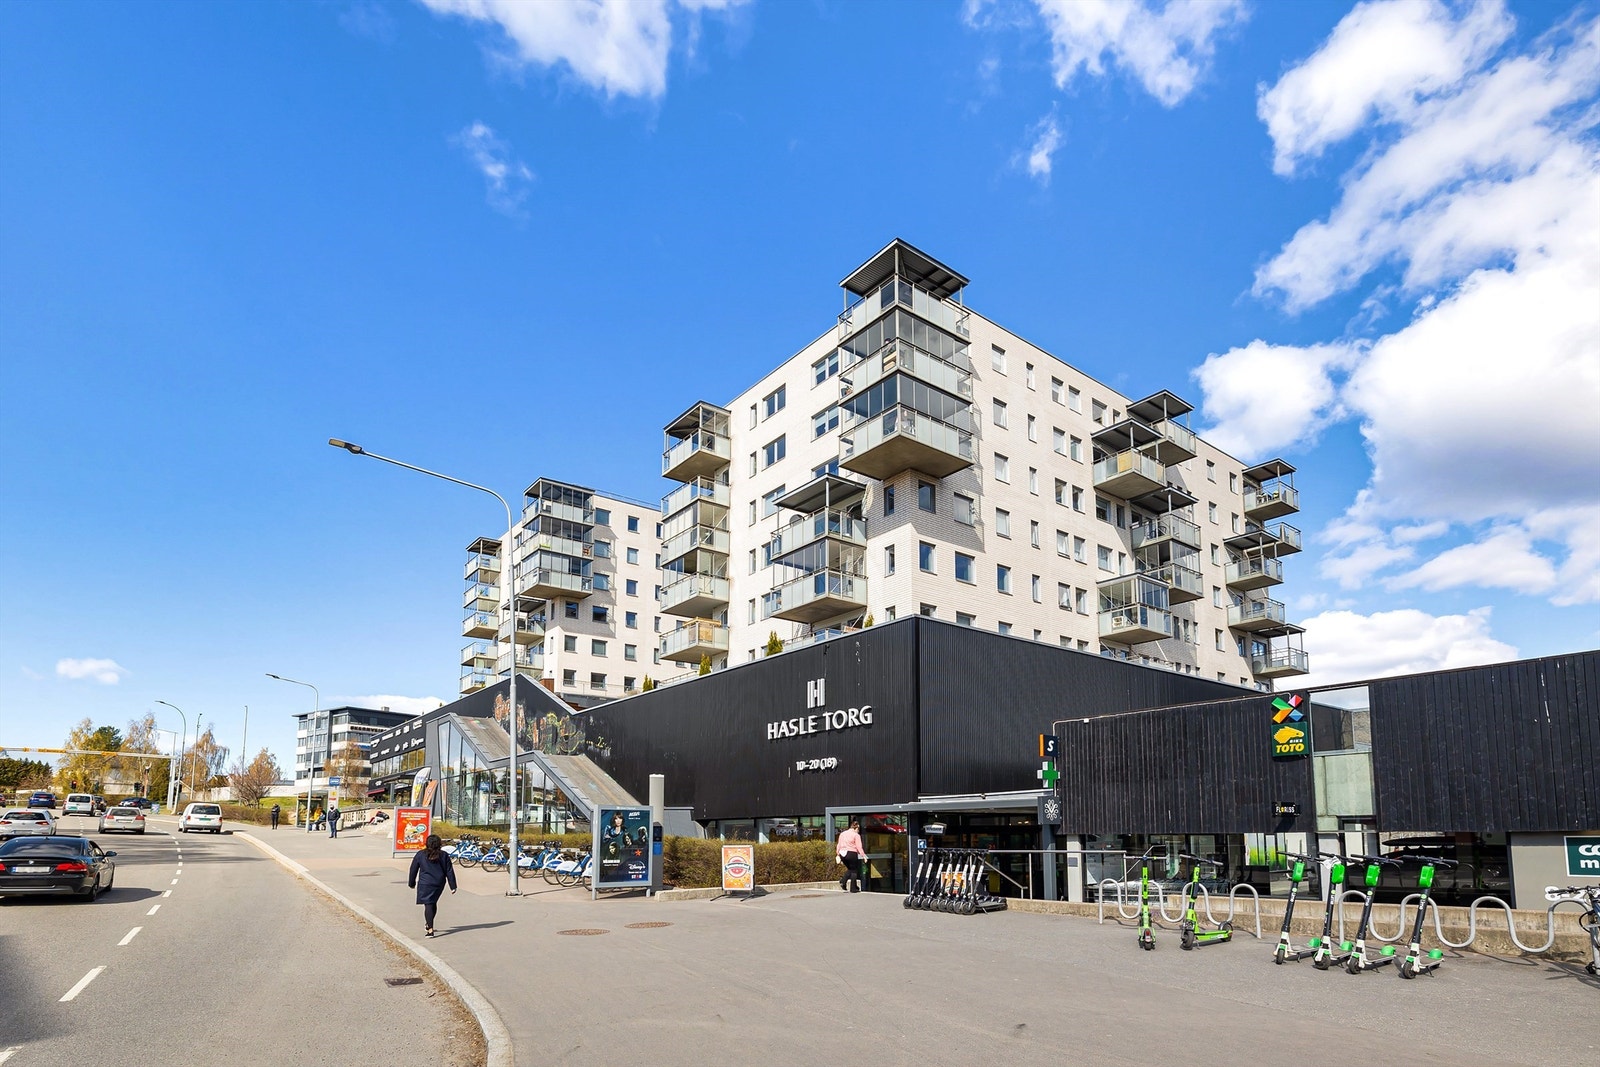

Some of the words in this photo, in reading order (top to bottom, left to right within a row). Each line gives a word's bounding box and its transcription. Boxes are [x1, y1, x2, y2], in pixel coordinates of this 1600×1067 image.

[767, 716, 817, 740] HASLE
[822, 705, 872, 730] TORG
[1046, 740, 1054, 752] S
[1276, 743, 1305, 754] TOTO
